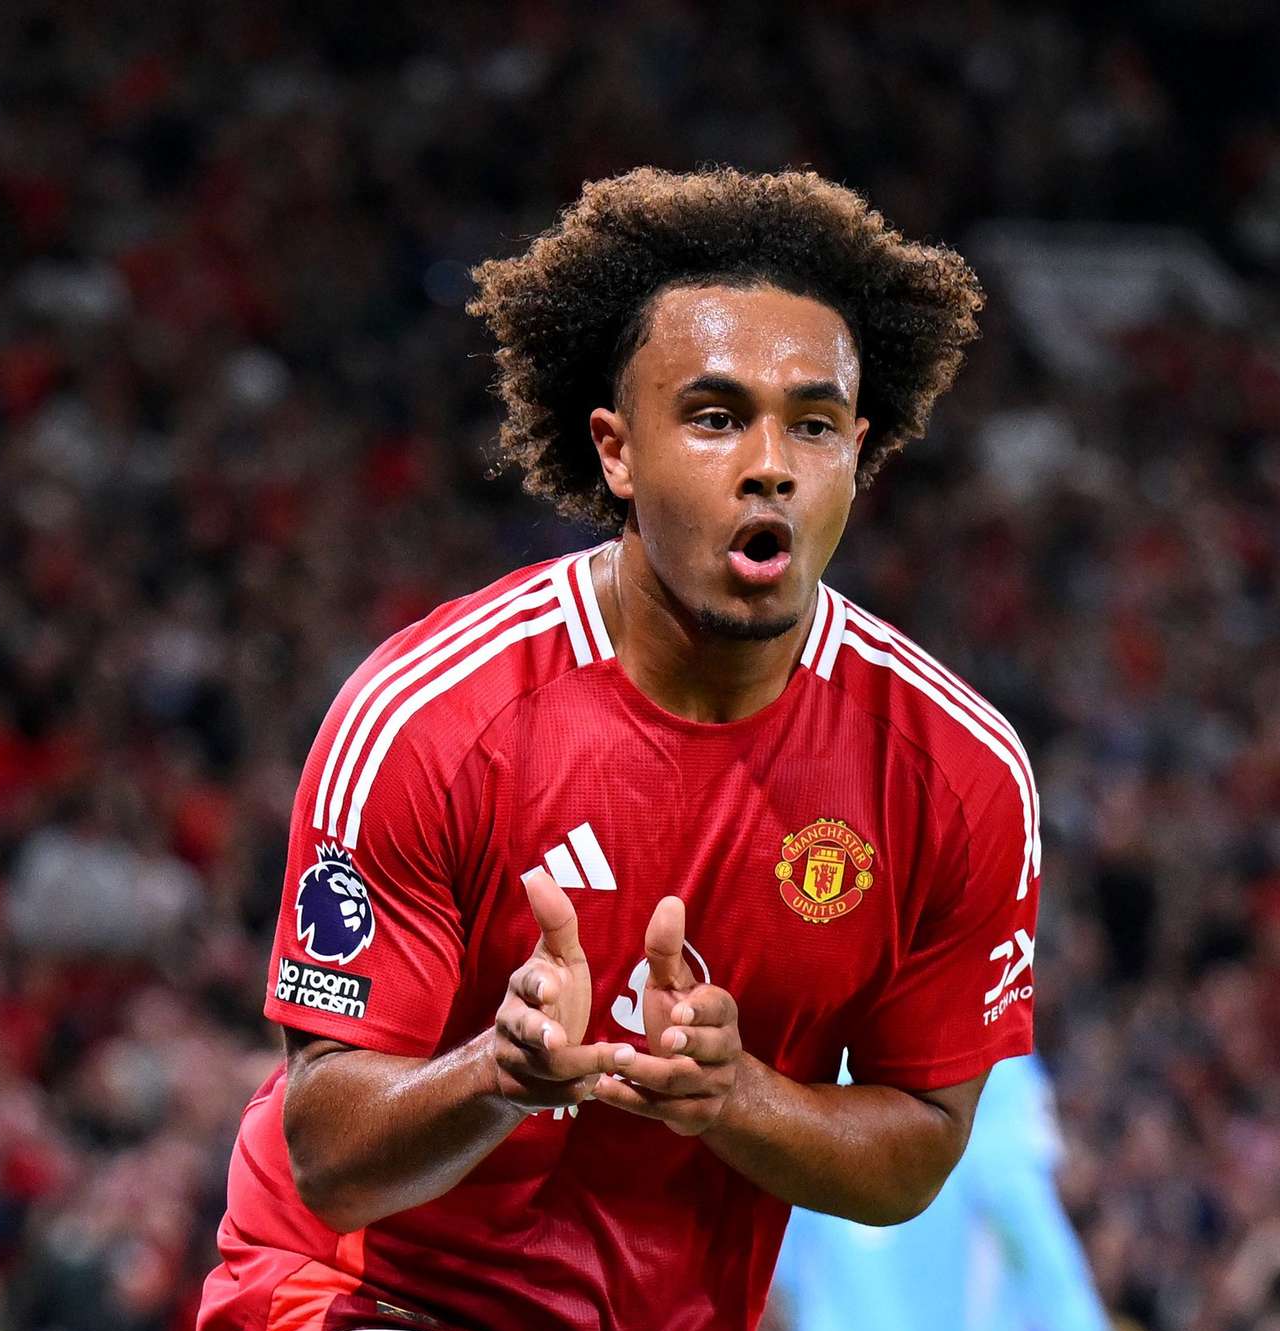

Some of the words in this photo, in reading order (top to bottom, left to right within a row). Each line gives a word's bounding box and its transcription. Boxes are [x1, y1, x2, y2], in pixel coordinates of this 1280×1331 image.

[788, 826, 867, 865] MANCHESTER
[792, 896, 847, 916] UNITED
[301, 968, 360, 998] room
[295, 986, 365, 1019] racism
